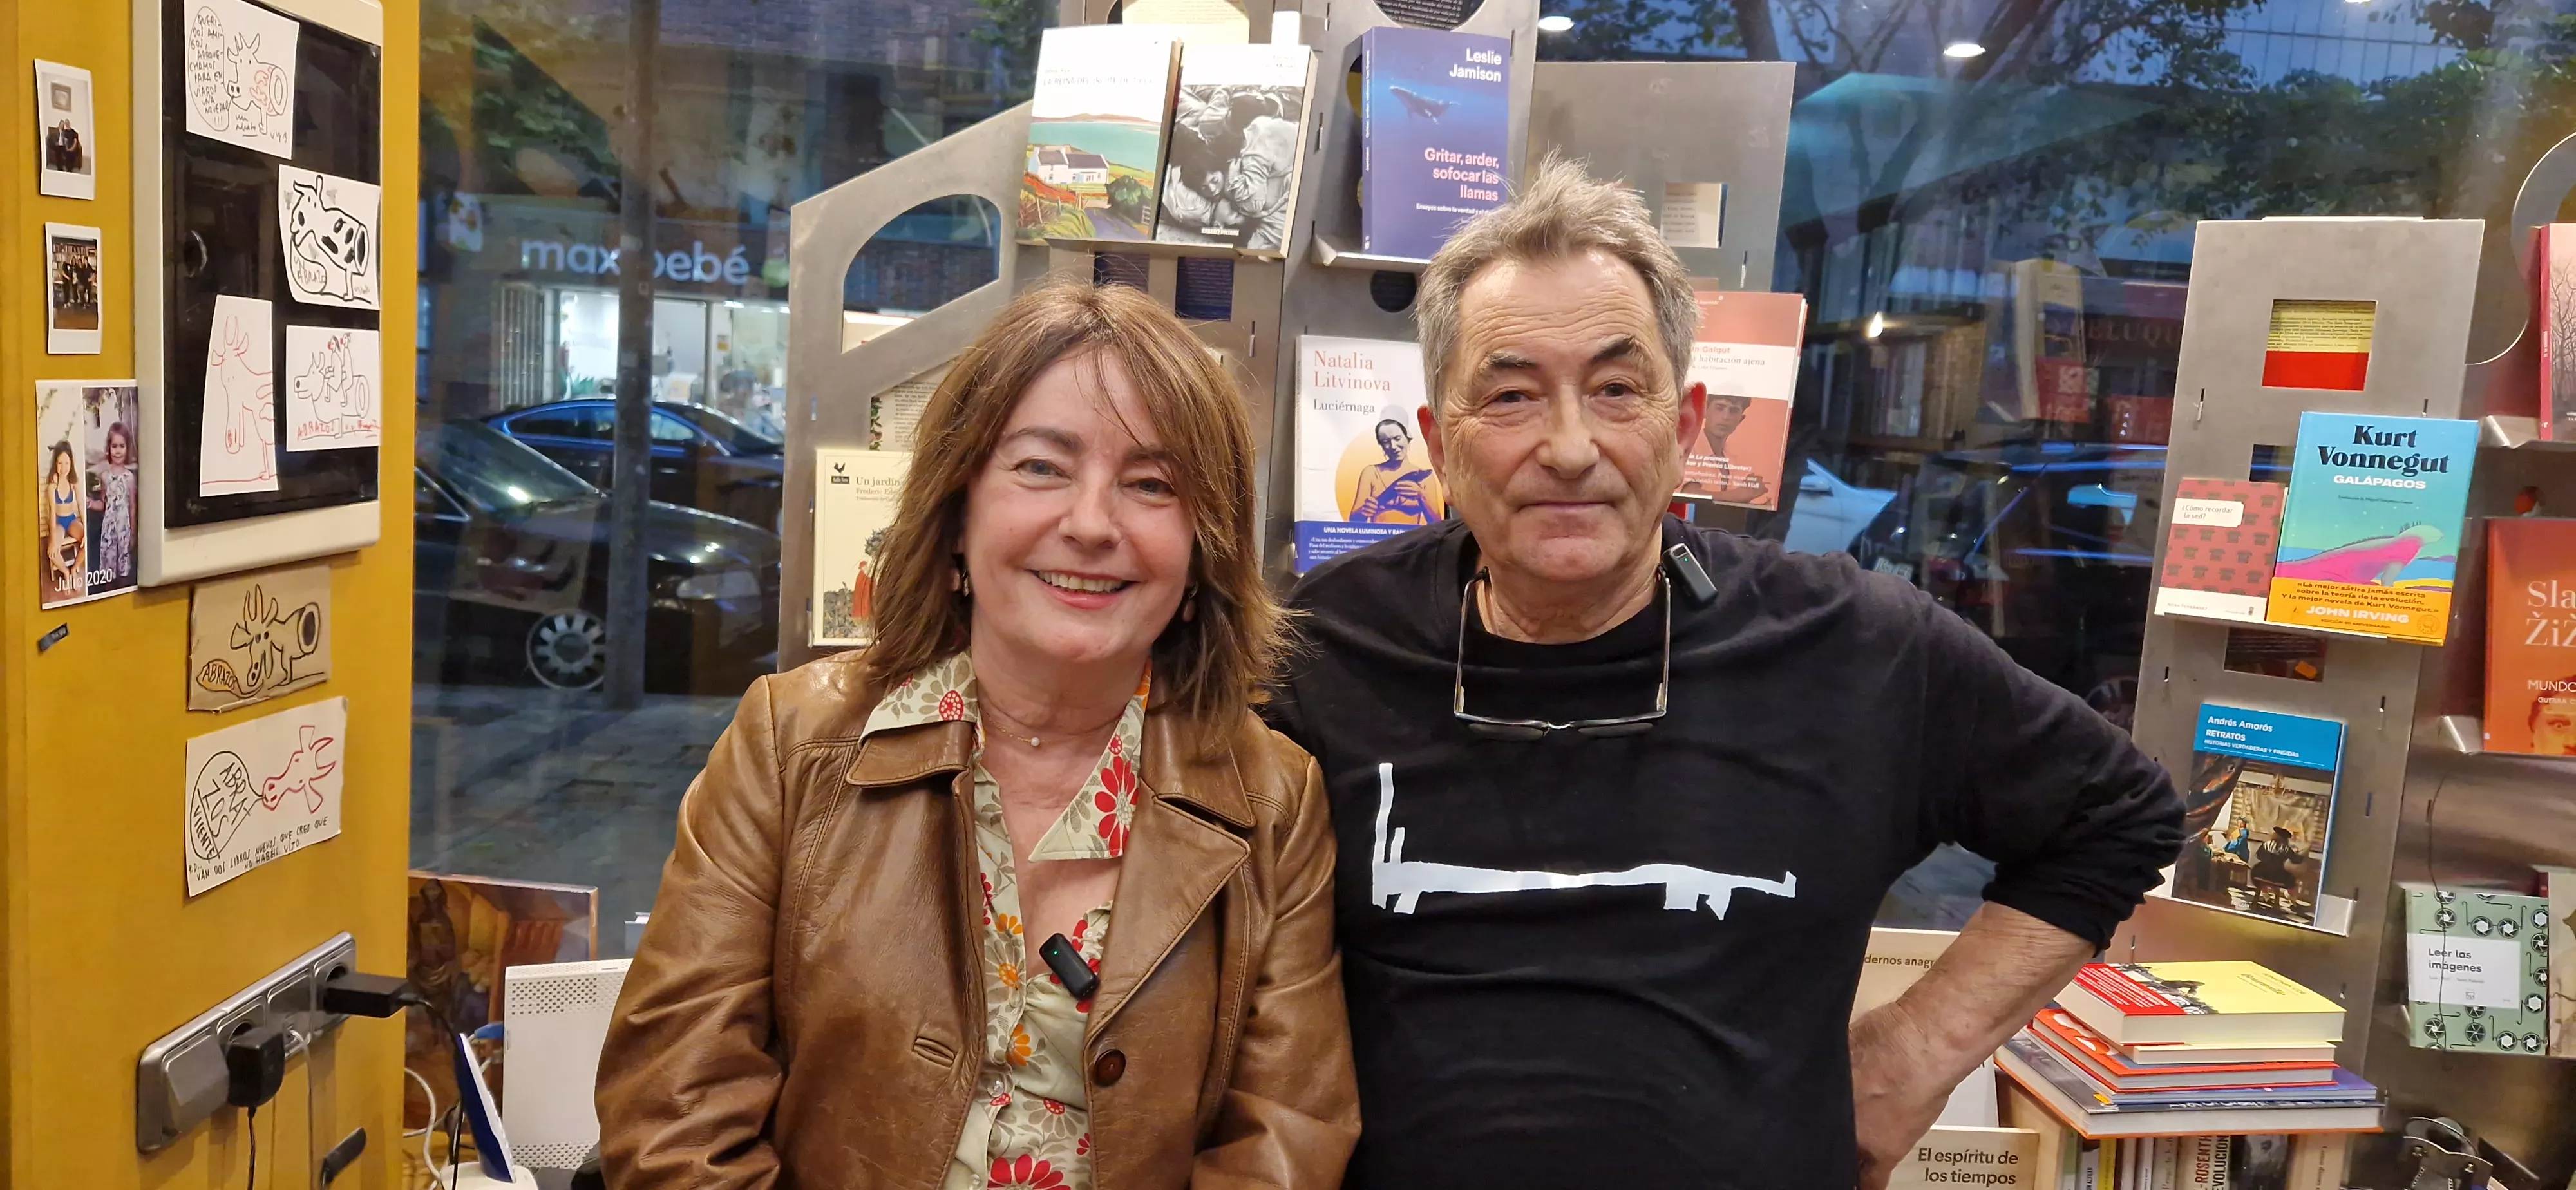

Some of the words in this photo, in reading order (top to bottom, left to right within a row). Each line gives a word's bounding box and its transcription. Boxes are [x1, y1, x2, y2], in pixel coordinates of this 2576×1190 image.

[1466, 48, 1502, 66] Leslie
[1448, 64, 1502, 82] Jamison
[1424, 146, 1464, 166] Gritar,
[1465, 151, 1500, 169] arder,
[1432, 165, 1482, 183] sofocar
[1482, 170, 1499, 185] las
[1460, 184, 1499, 201] llamas
[1313, 350, 1374, 371] Natalia
[1313, 371, 1392, 392] Litvinova
[1313, 399, 1376, 415] Luciérnaga
[2352, 424, 2419, 448] Kurt
[2317, 445, 2450, 478] Vonnegut
[2333, 475, 2427, 489] GALÁPAGOS
[2182, 504, 2204, 513] ¿Cómo
[54, 573, 84, 593] Julio
[86, 567, 113, 588] 2020
[2298, 594, 2324, 603] mejor
[2324, 597, 2353, 605] novela
[2315, 583, 2340, 591] mejor
[2340, 584, 2367, 594] sátira
[2367, 586, 2394, 596] jamás
[2394, 589, 2427, 599] escrita
[2331, 590, 2357, 599] teoría
[2380, 595, 2425, 605] evolución.
[2305, 605, 2351, 619] JOHN
[2352, 609, 2410, 624] IRVING
[2537, 696, 2568, 705] GUERRA
[2208, 715, 2238, 728] Andrés
[2239, 720, 2274, 732] Amorós
[2205, 728, 2246, 742] RETRATOS
[2204, 739, 2231, 748] HISTORIAS
[2231, 742, 2268, 753] VERDADERAS
[2273, 748, 2300, 758] FINGIDAS
[196, 869, 211, 882] VAN
[314, 815, 328, 829] QUE
[2428, 947, 2453, 958] Leer
[2455, 949, 2472, 959] las
[2429, 959, 2483, 973] imágenes
[1917, 1147, 1932, 1162] El
[1933, 1148, 1995, 1167] espíritu
[1997, 1149, 2020, 1166] de
[1924, 1167, 1948, 1184] los
[1950, 1167, 2017, 1187] tiempos
